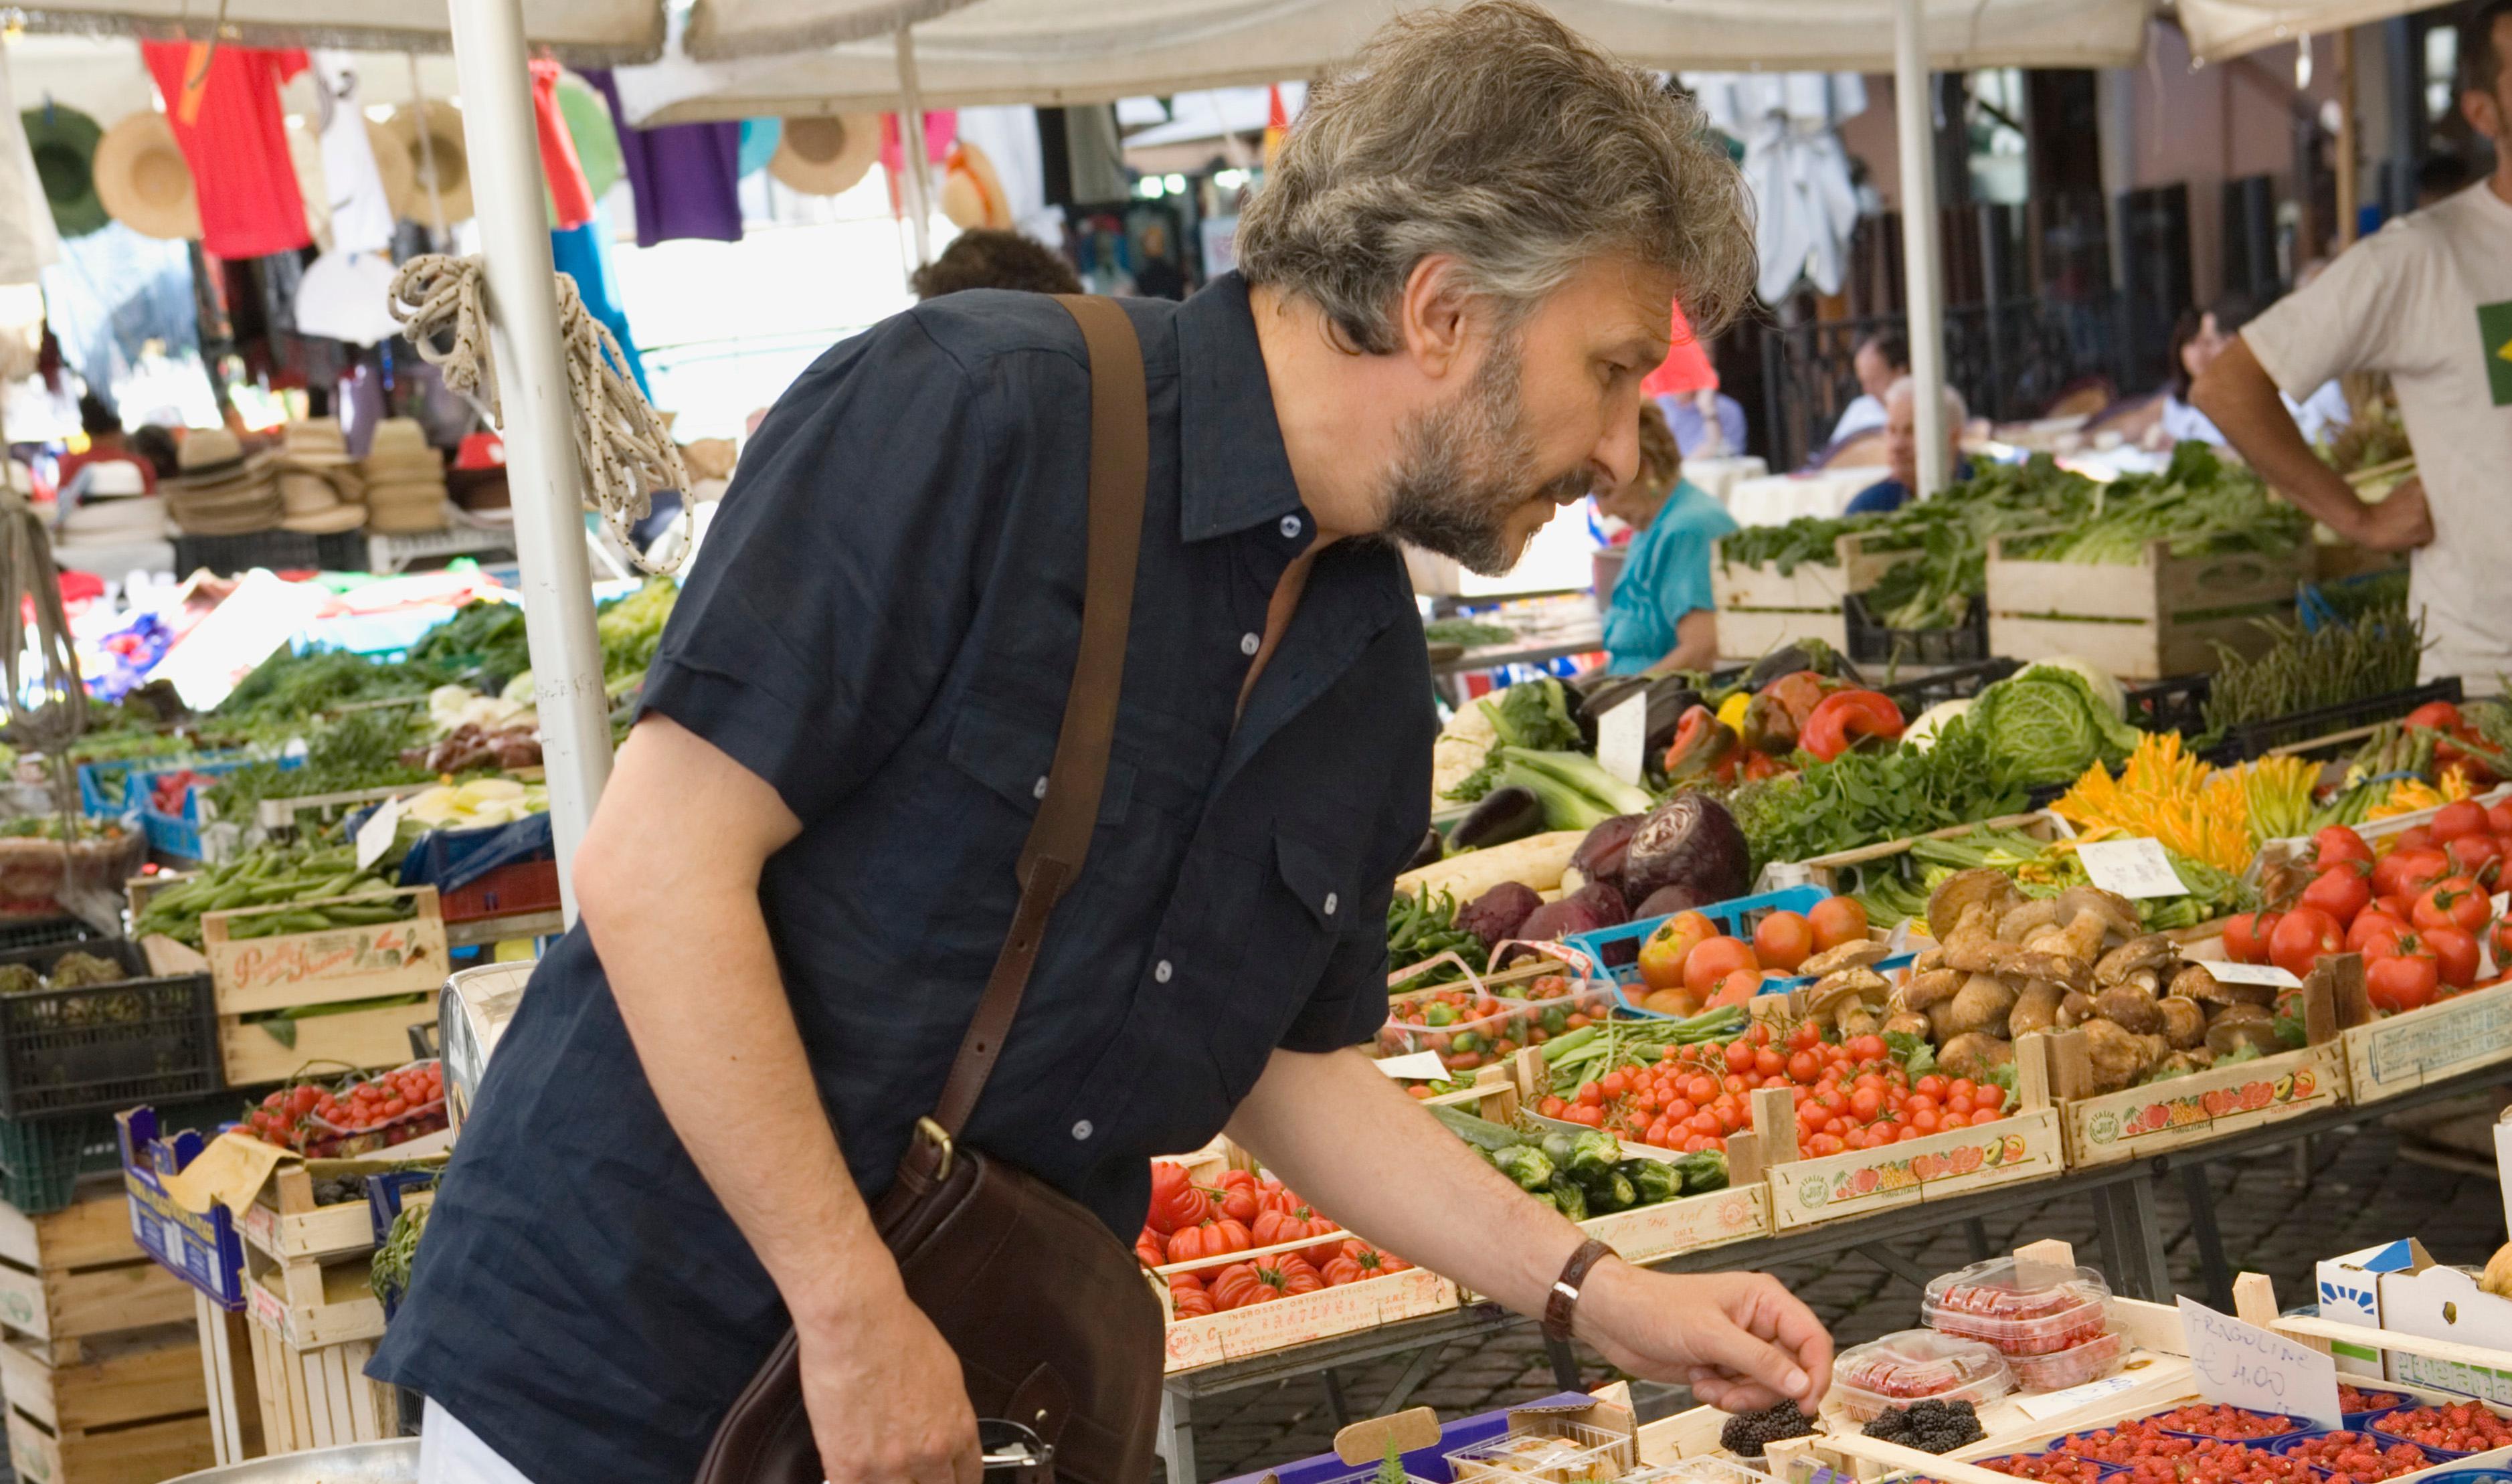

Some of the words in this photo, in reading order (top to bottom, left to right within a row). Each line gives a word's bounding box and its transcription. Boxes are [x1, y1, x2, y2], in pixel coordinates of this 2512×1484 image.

[2090, 1111, 2116, 1123] ITALIA
[1800, 1174, 1826, 1186] ITALIA
[1227, 1304, 1283, 1321] INGROSSO
